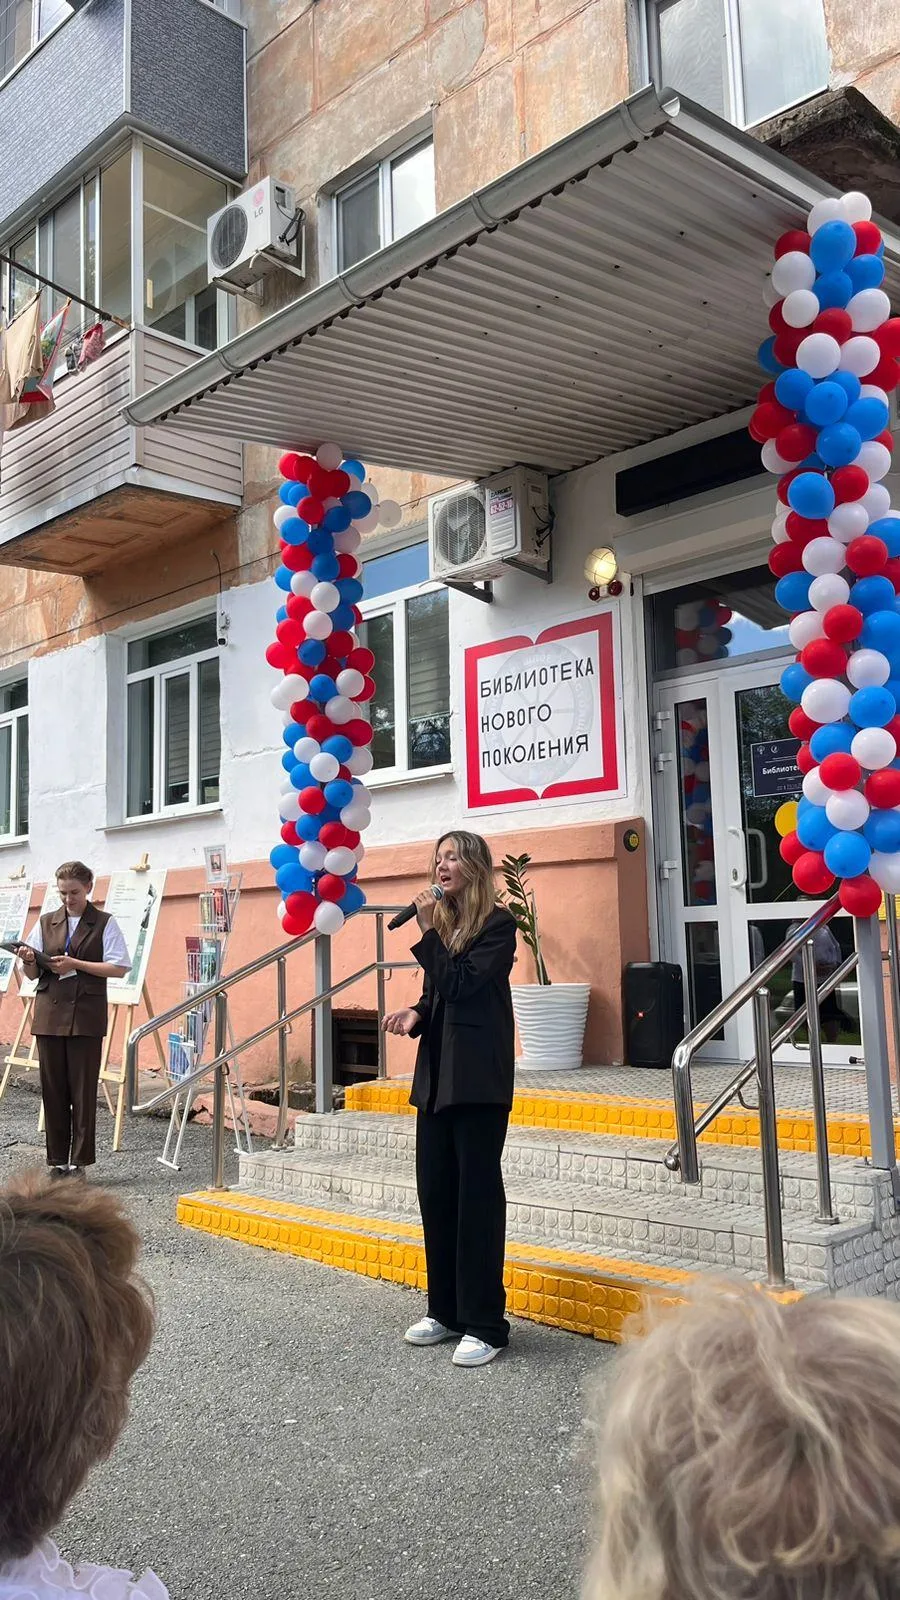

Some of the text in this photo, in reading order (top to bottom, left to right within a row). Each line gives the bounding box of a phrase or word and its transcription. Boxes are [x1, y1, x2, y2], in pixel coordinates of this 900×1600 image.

[254, 206, 264, 218] LG
[480, 657, 594, 698] БИБЛИОТЕКА
[481, 703, 552, 733] НОВОГО
[482, 734, 589, 768] ПОКОЛЕНИЯ
